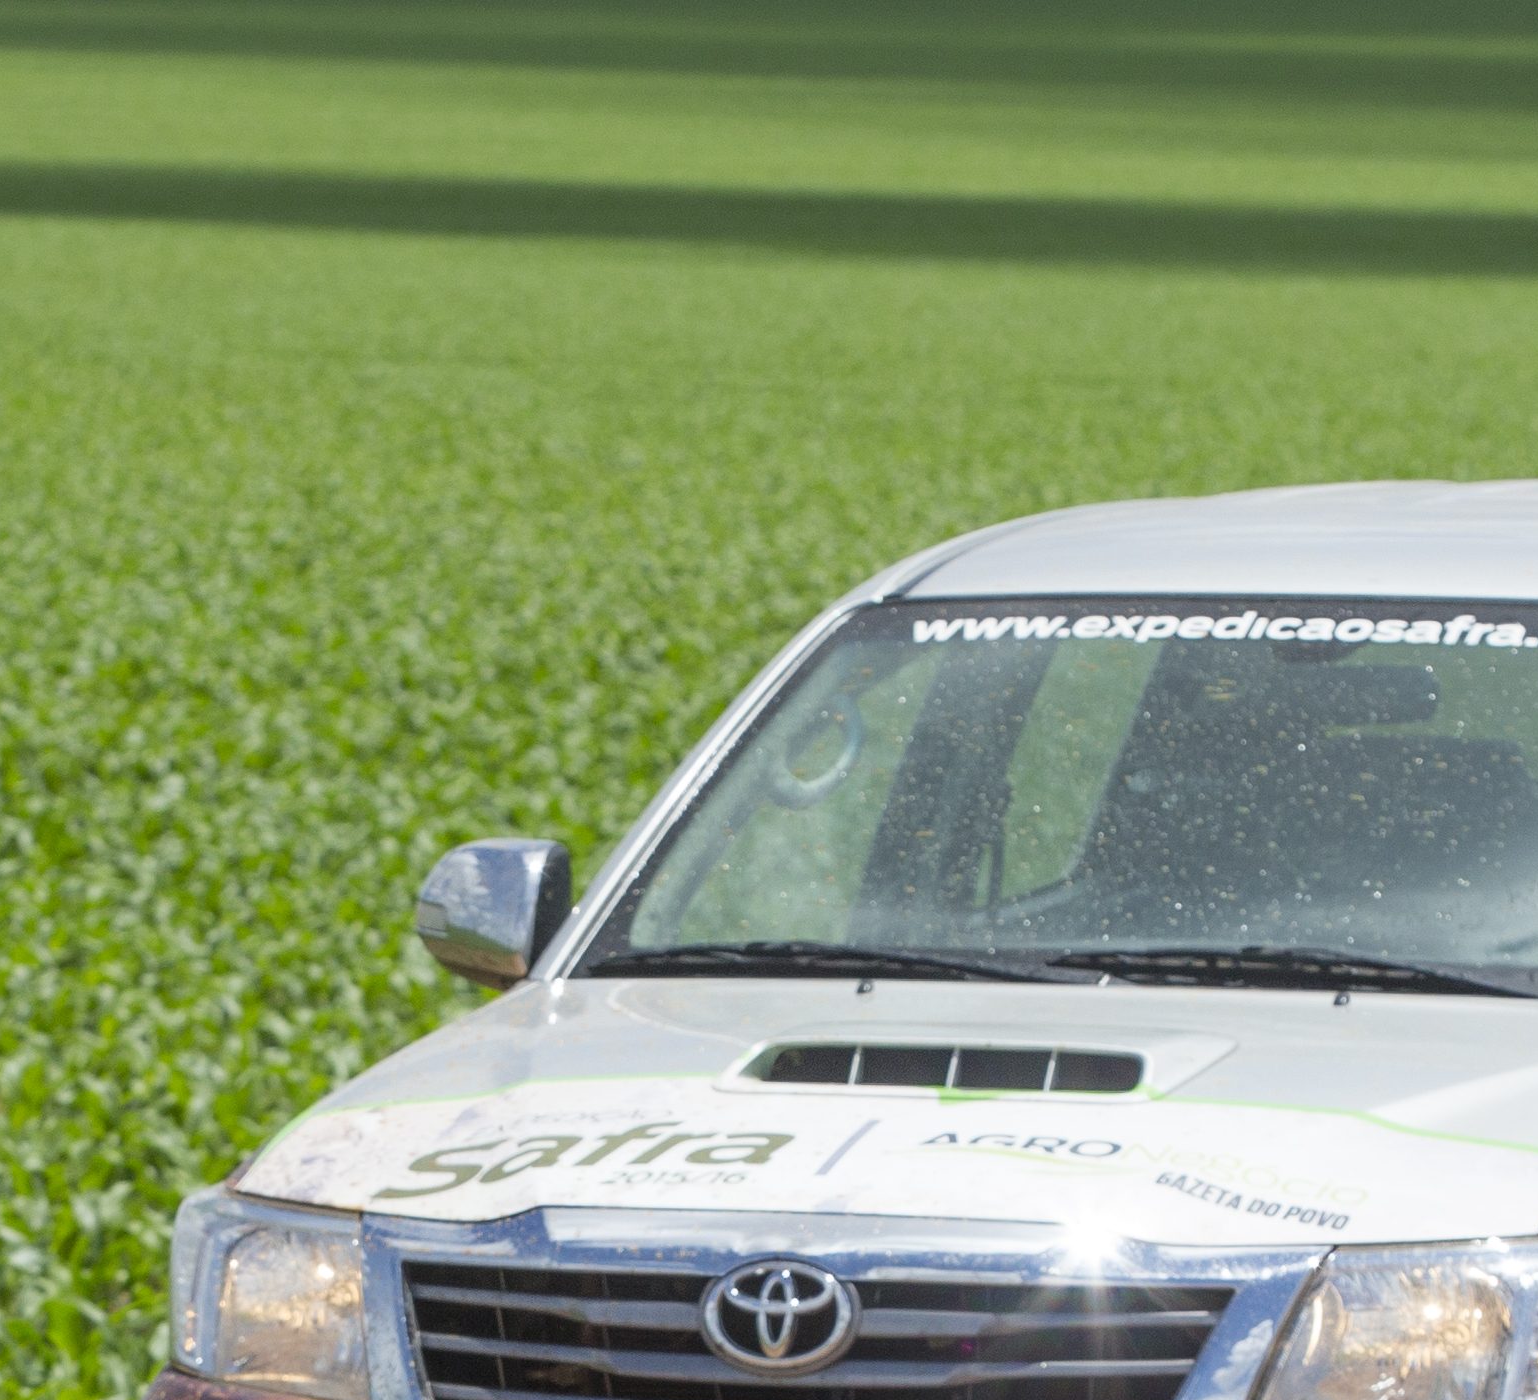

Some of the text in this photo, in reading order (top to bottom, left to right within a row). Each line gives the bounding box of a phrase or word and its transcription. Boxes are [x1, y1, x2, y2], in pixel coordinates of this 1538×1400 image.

[371, 1121, 795, 1199] Safra
[600, 1169, 749, 1185] 2015/16
[1154, 1171, 1352, 1232] GAZETA DO POVO
